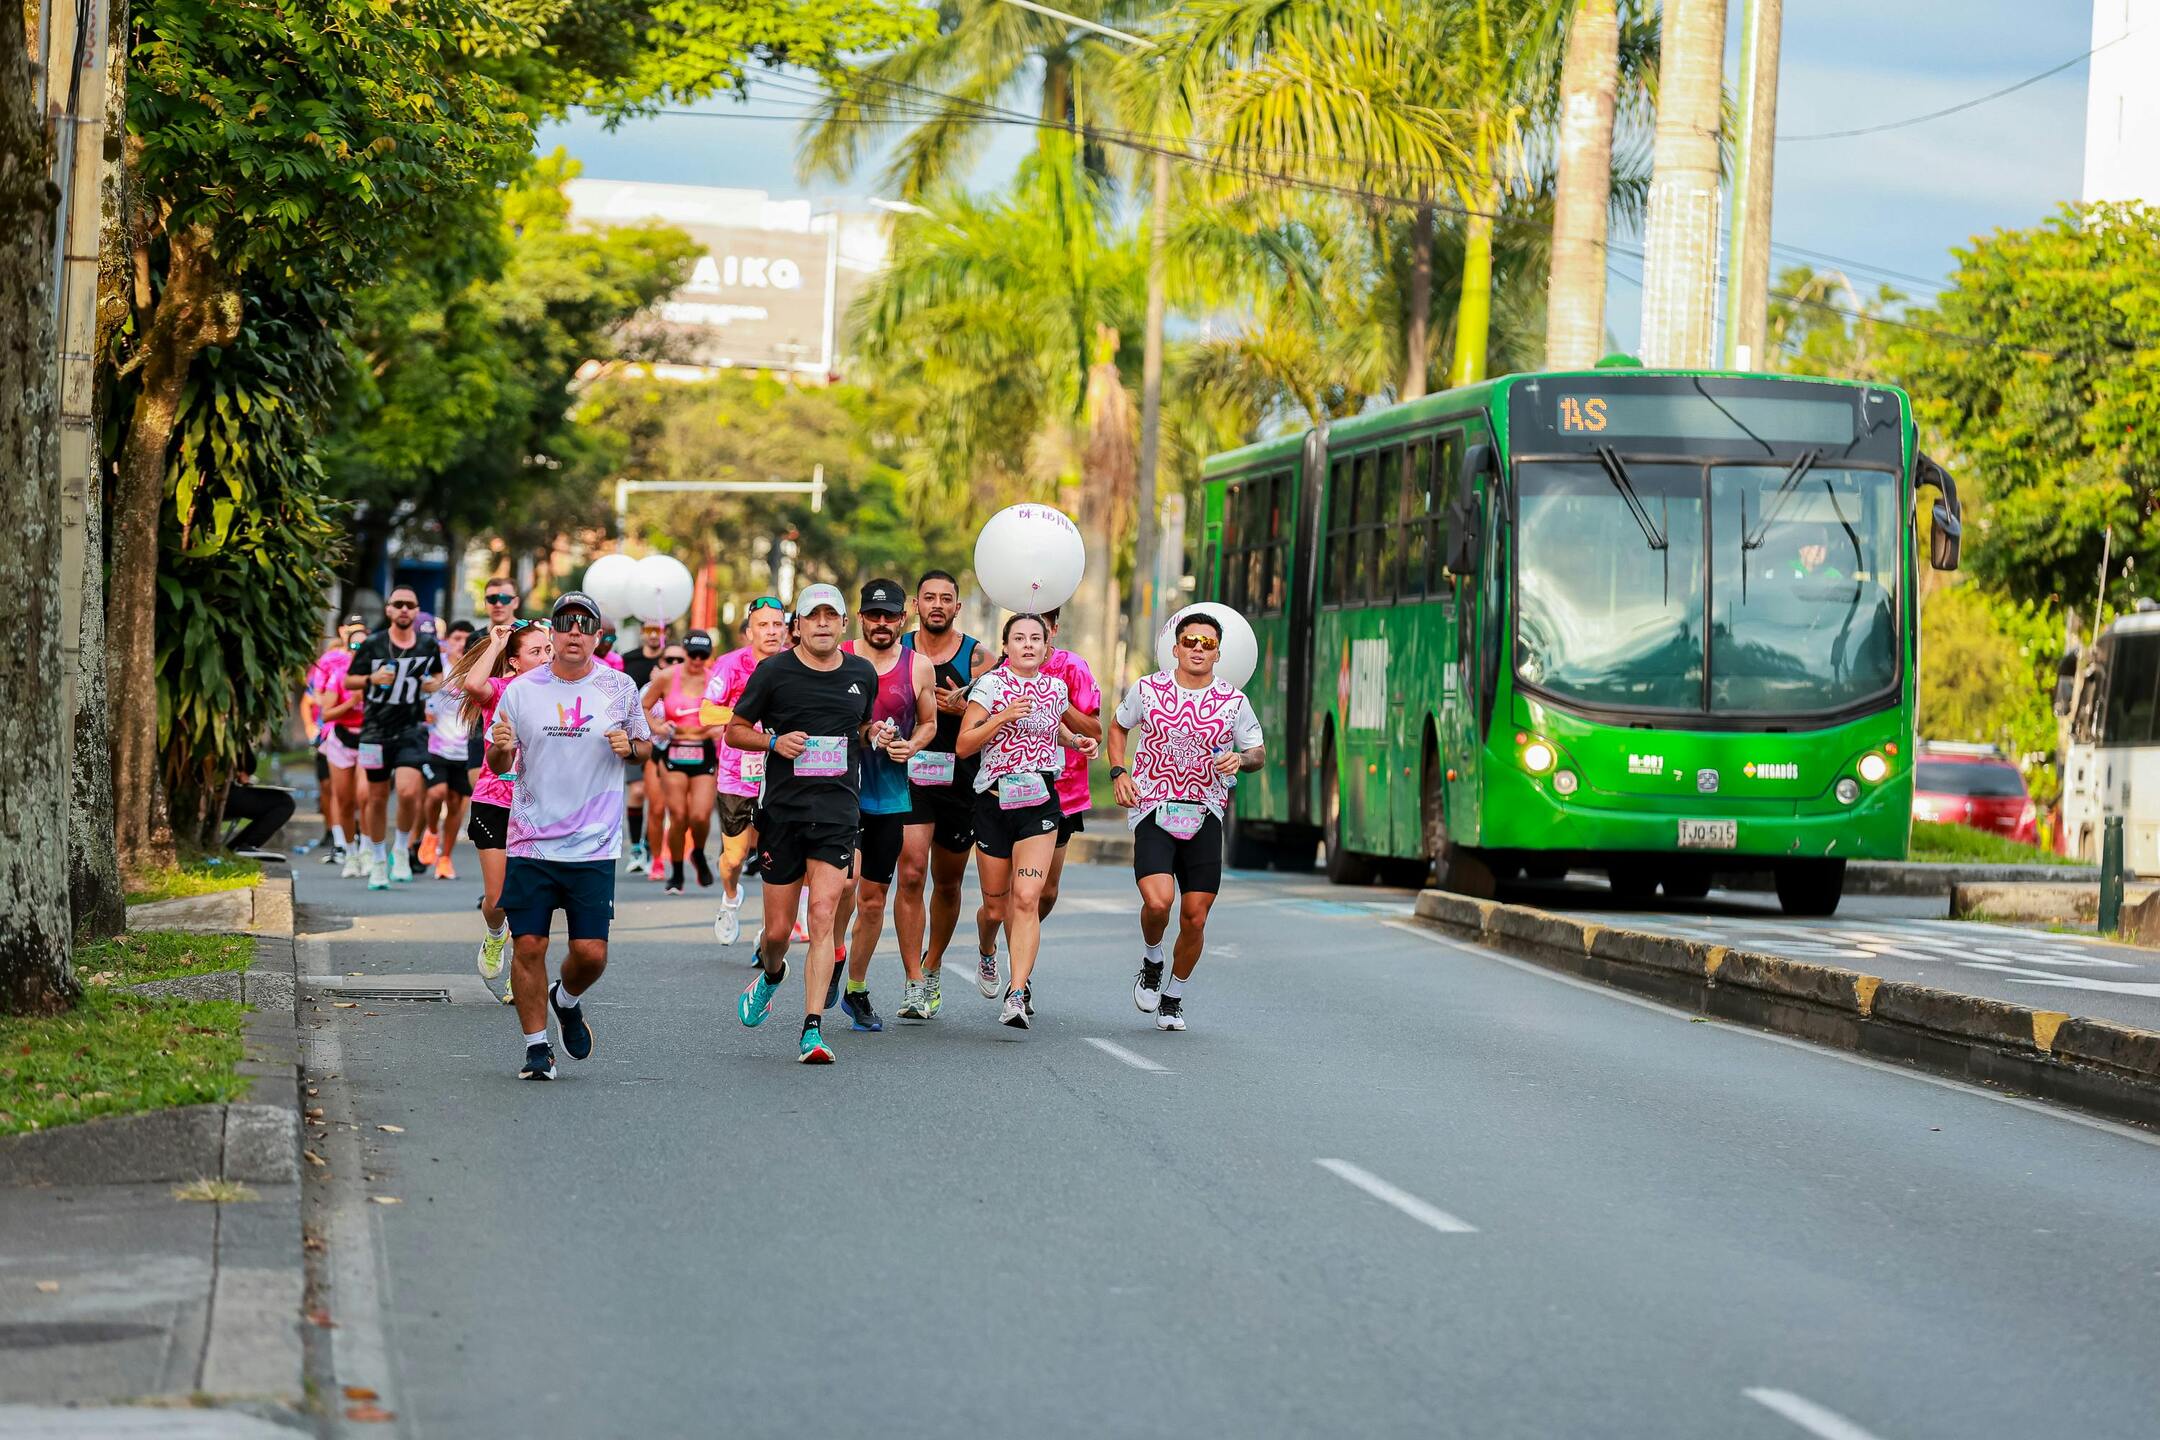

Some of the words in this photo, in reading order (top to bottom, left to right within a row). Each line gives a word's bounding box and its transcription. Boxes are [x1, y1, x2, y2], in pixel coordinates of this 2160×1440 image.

[542, 725, 591, 733] ANDARIEGOS
[1017, 719, 1045, 730] Alma
[1161, 744, 1193, 758] Alma
[801, 750, 842, 764] 2305
[1017, 868, 1043, 879] RUN
